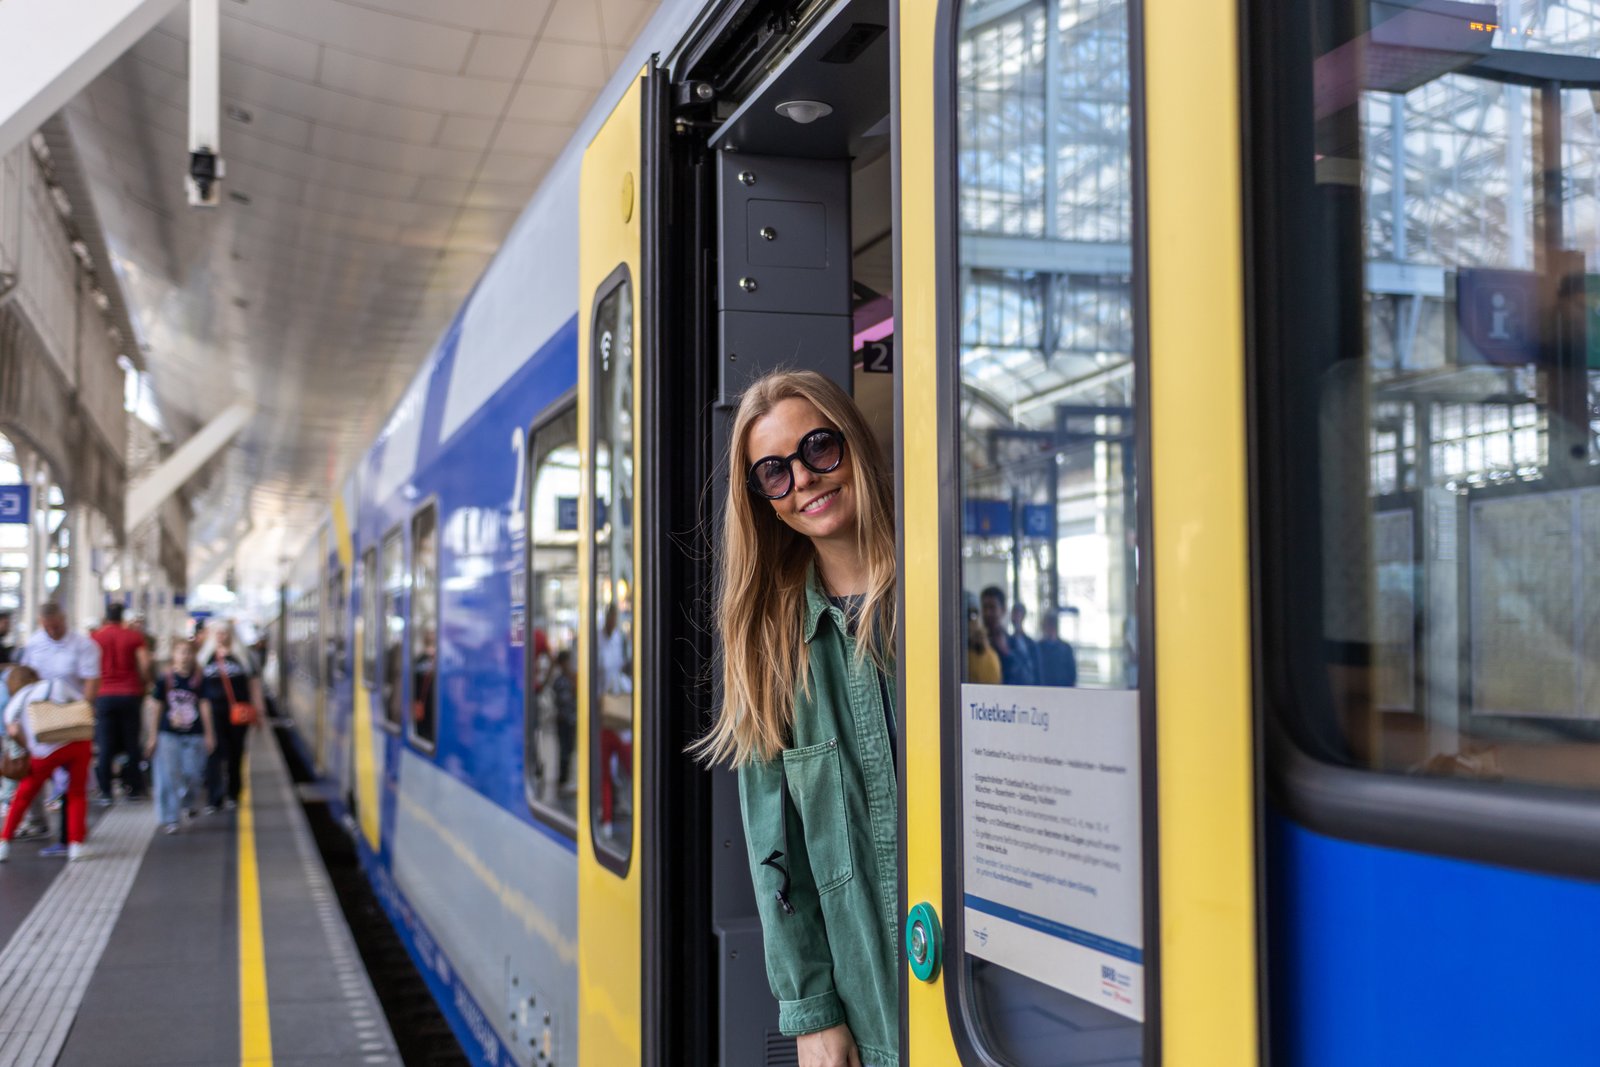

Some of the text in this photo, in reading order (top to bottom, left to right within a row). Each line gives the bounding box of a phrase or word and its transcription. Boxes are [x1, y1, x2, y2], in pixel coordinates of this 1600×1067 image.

[871, 343, 888, 371] 2
[970, 703, 1016, 723] Ticketkauf
[1031, 706, 1049, 732] Zug
